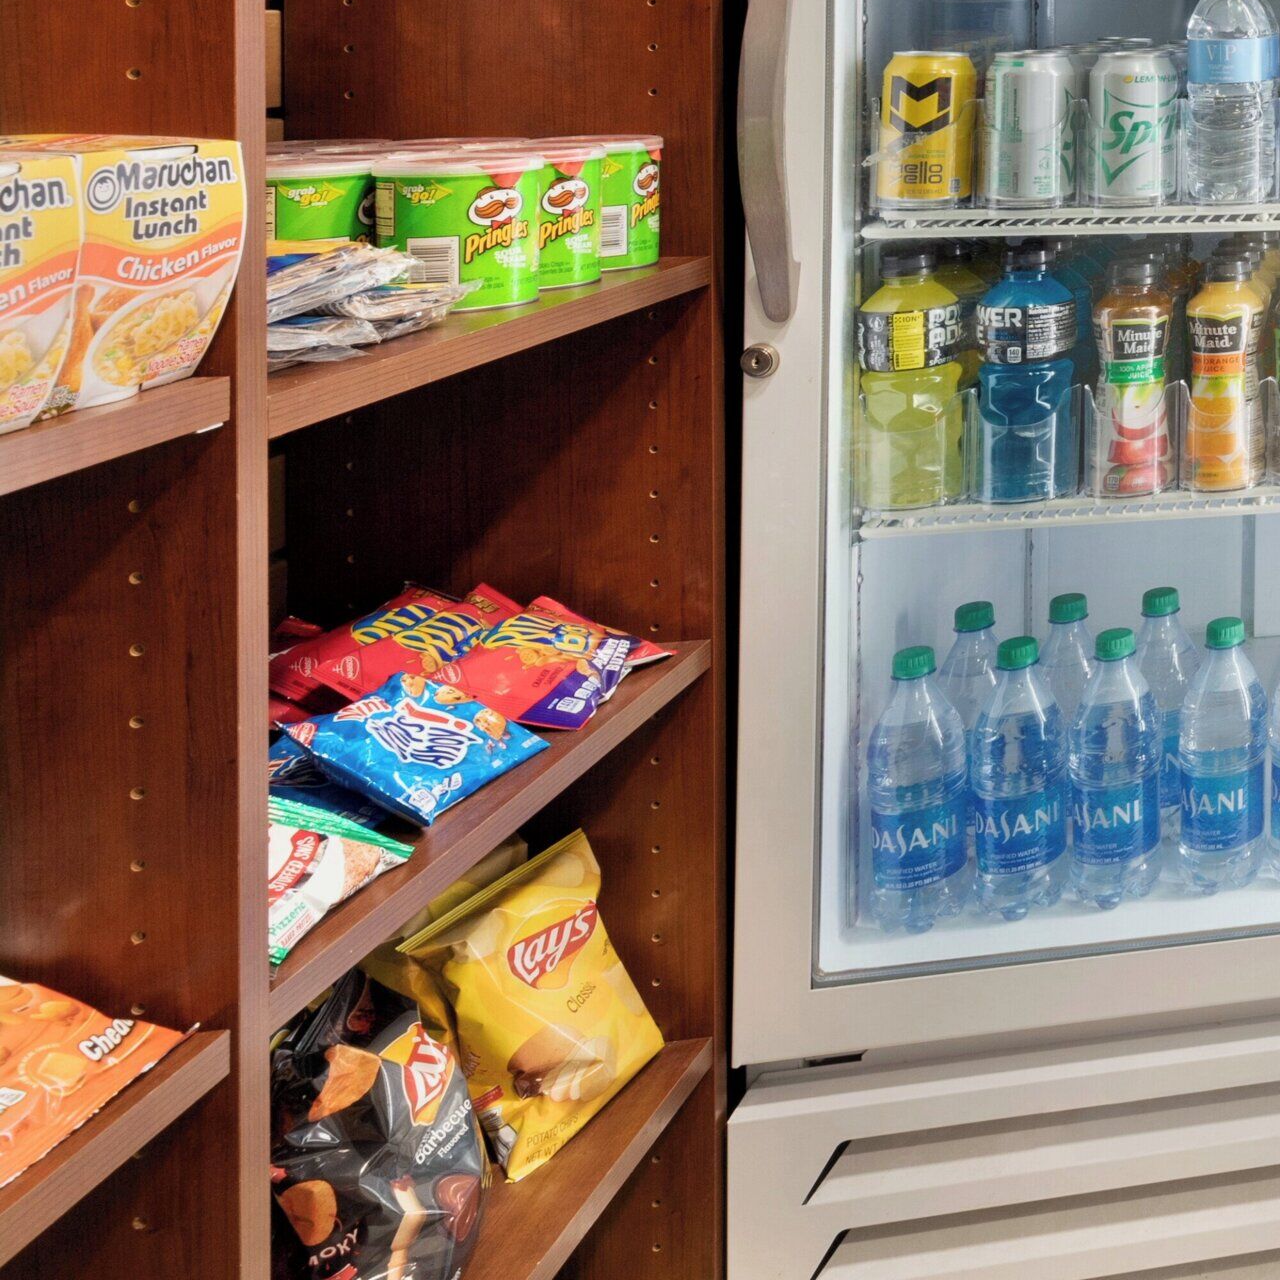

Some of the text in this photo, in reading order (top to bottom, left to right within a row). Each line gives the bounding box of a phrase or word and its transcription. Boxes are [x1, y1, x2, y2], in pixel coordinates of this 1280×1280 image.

[115, 156, 234, 191] Maruchan
[125, 190, 207, 219] Instant
[287, 185, 315, 198] grab
[402, 184, 425, 196] grab
[132, 214, 198, 241] Lunch
[464, 219, 528, 264] Pringles
[539, 208, 594, 249] Pringles
[117, 235, 238, 282] Chicken Flavor
[28, 266, 74, 296] Flavor
[1117, 327, 1162, 343] Minute
[1189, 322, 1238, 336] Minute
[1194, 334, 1233, 349] Maid
[1008, 348, 1020, 356] 140
[873, 813, 957, 858] DASANI
[975, 801, 1059, 844] DASANI
[511, 905, 597, 986] Lay's
[566, 981, 598, 1015] Classic
[415, 1098, 473, 1166] Barbecue
[437, 1123, 470, 1159] Flavored
[526, 1126, 558, 1148] POTATO
